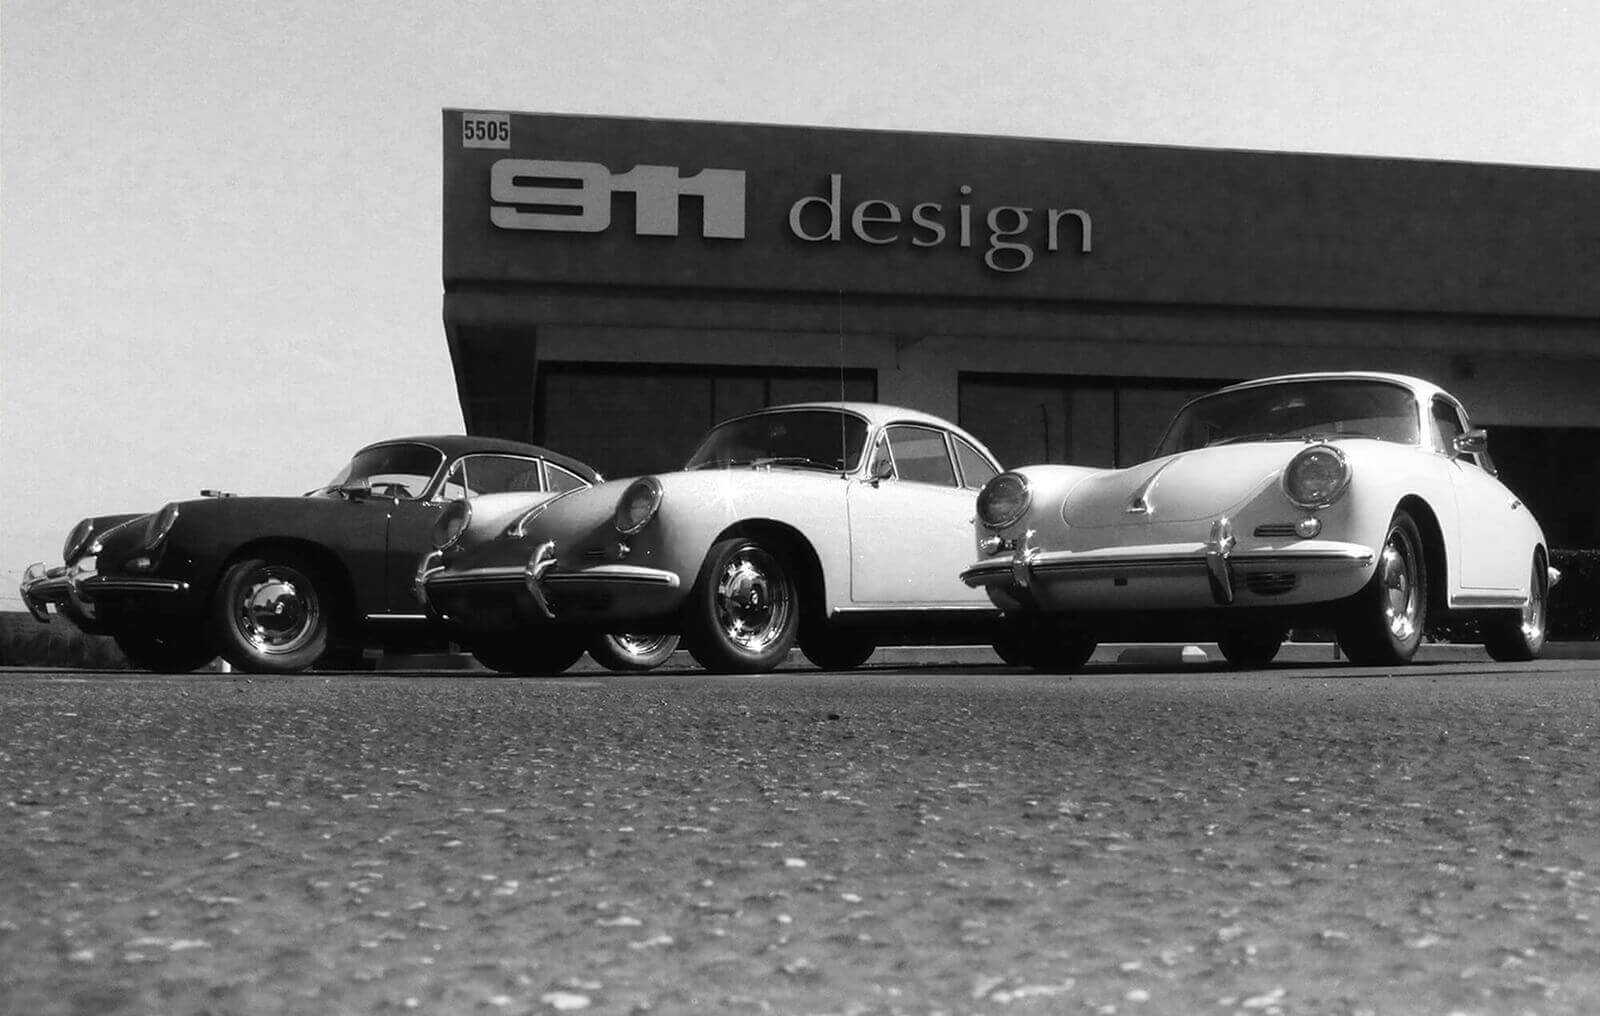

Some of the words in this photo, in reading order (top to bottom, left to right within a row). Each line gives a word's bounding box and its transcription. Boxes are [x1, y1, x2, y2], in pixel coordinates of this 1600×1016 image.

[464, 120, 509, 141] 5505
[490, 158, 746, 239] 911
[789, 174, 1092, 272] design
